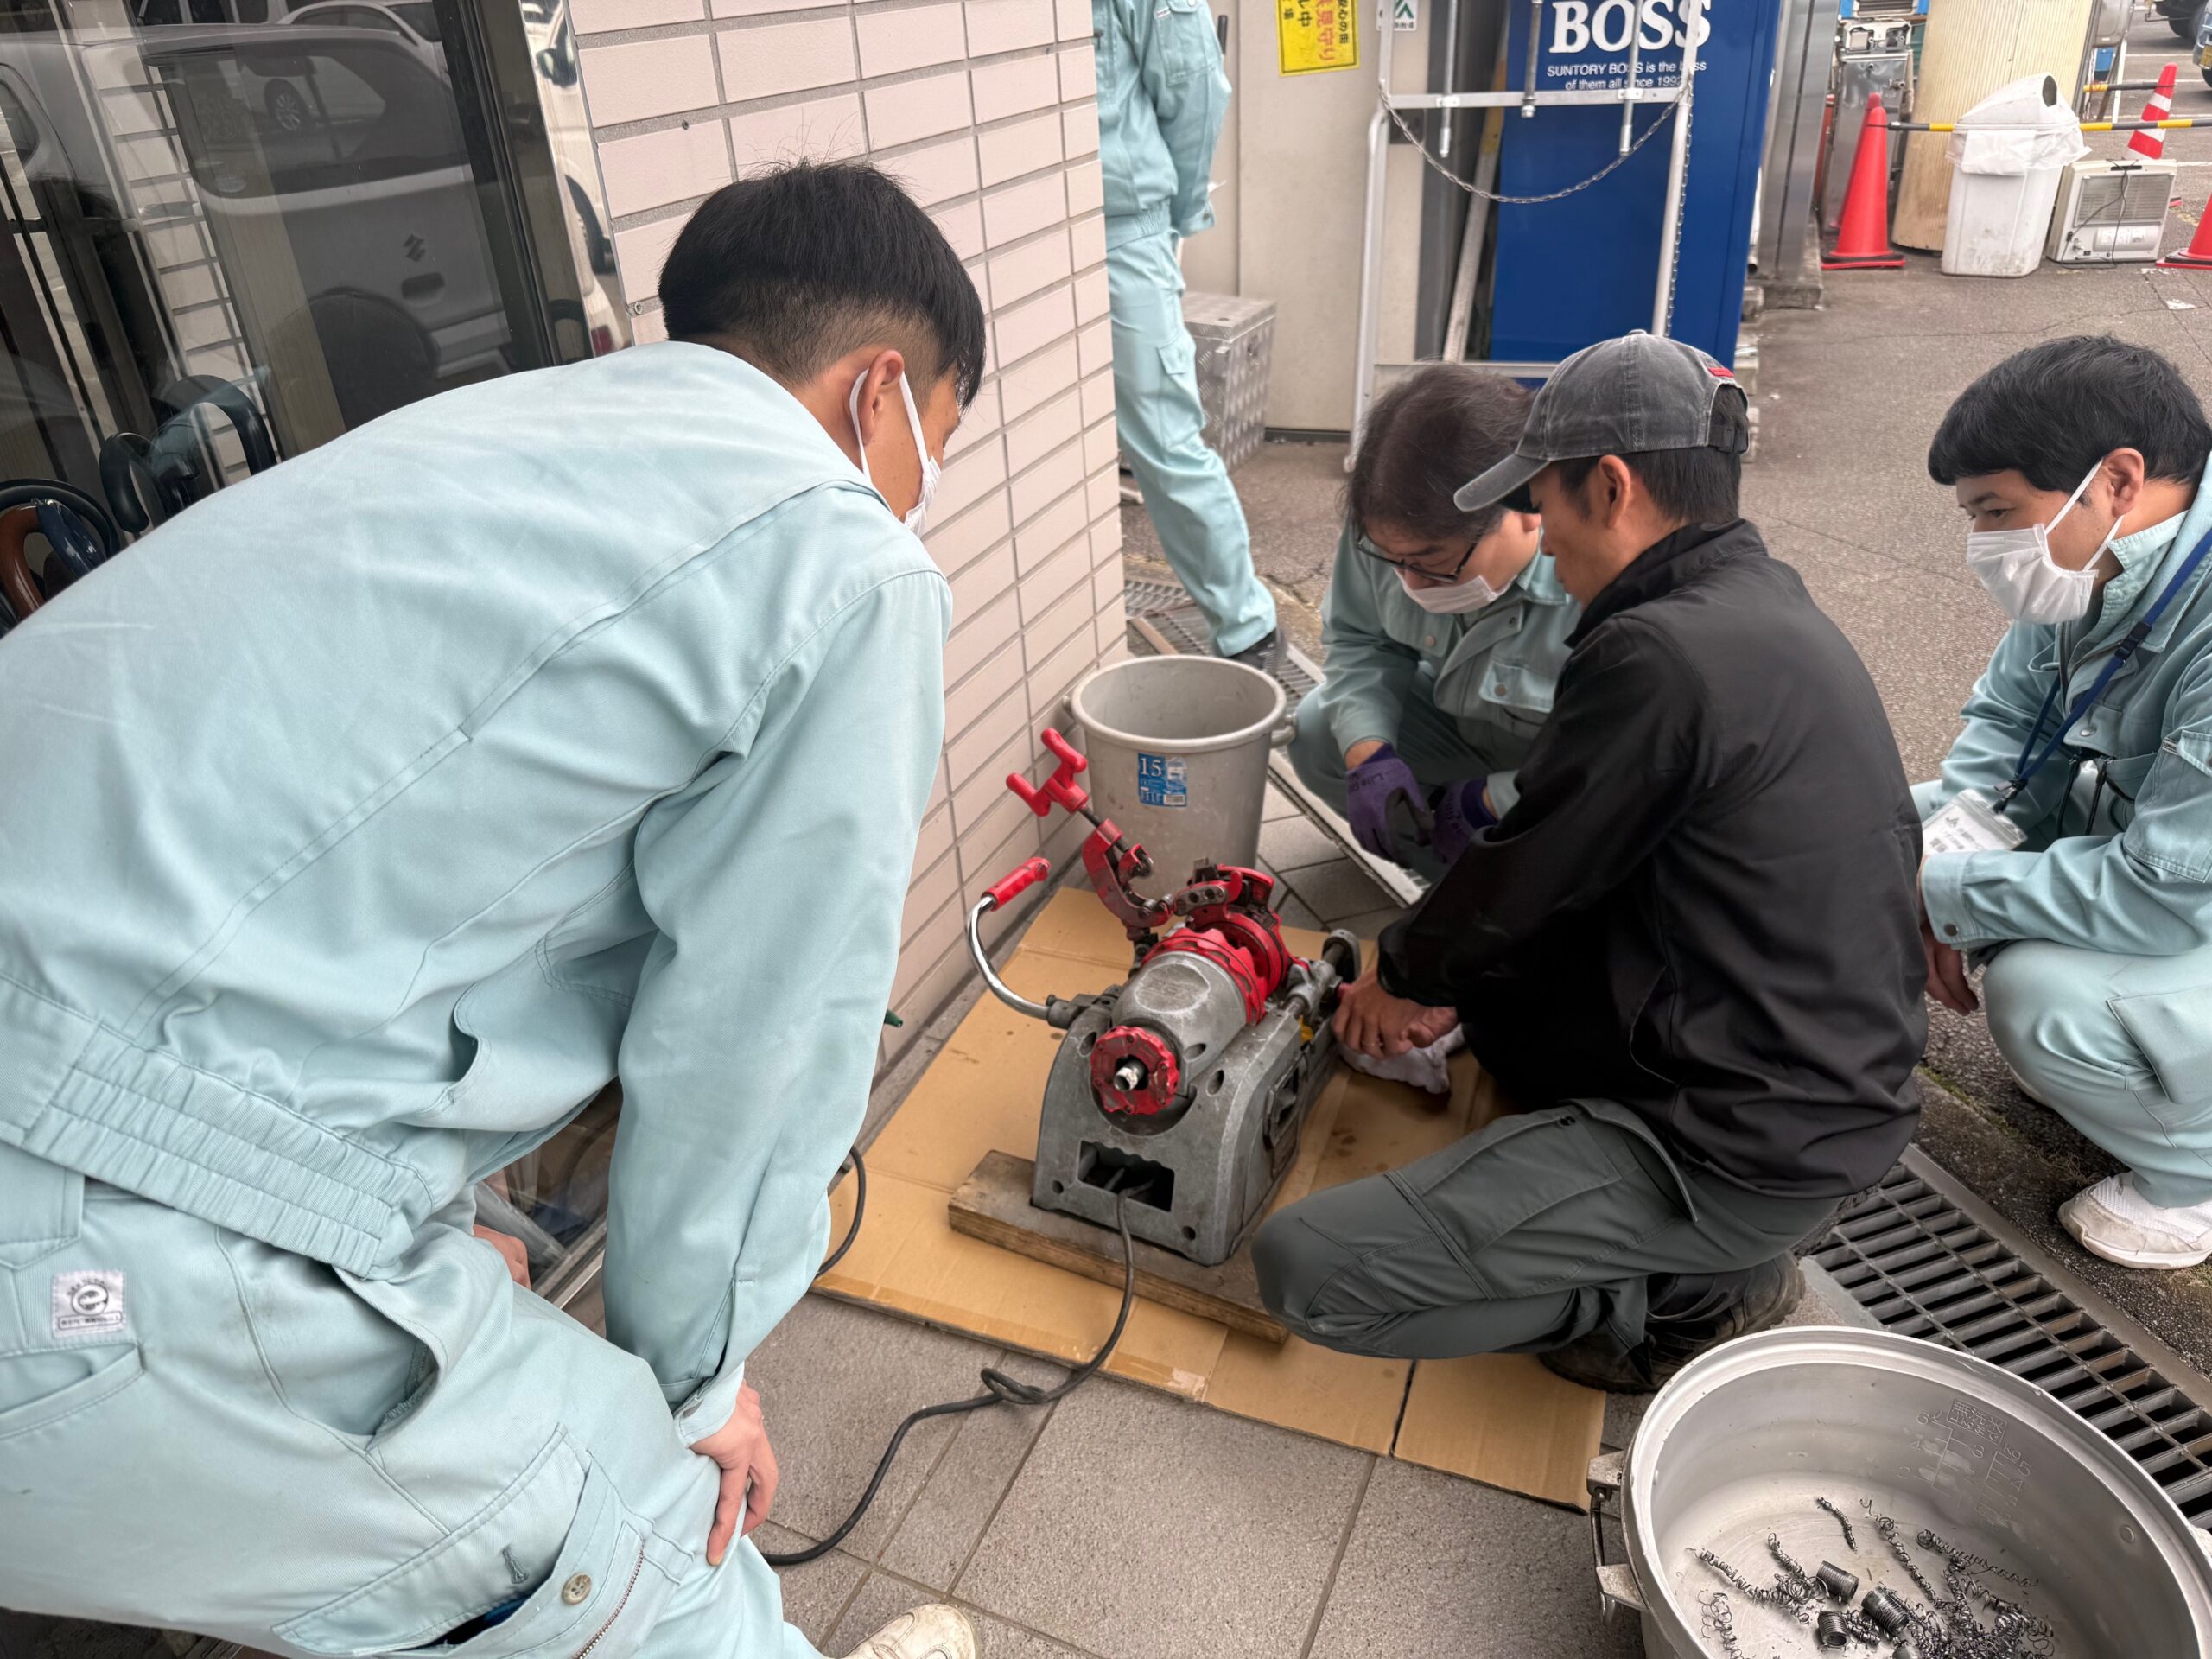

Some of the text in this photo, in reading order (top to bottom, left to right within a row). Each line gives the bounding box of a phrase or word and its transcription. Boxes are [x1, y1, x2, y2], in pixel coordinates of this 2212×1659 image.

[1548, 0, 1712, 53] BOSS
[1546, 63, 1606, 77] SUNTORY
[1608, 61, 1644, 75] BOS
[1645, 61, 1656, 73] is
[1658, 60, 1676, 73] the
[1565, 79, 1577, 91] of
[1578, 79, 1606, 90] them
[1608, 77, 1623, 89] all
[1140, 757, 1163, 777] 15
